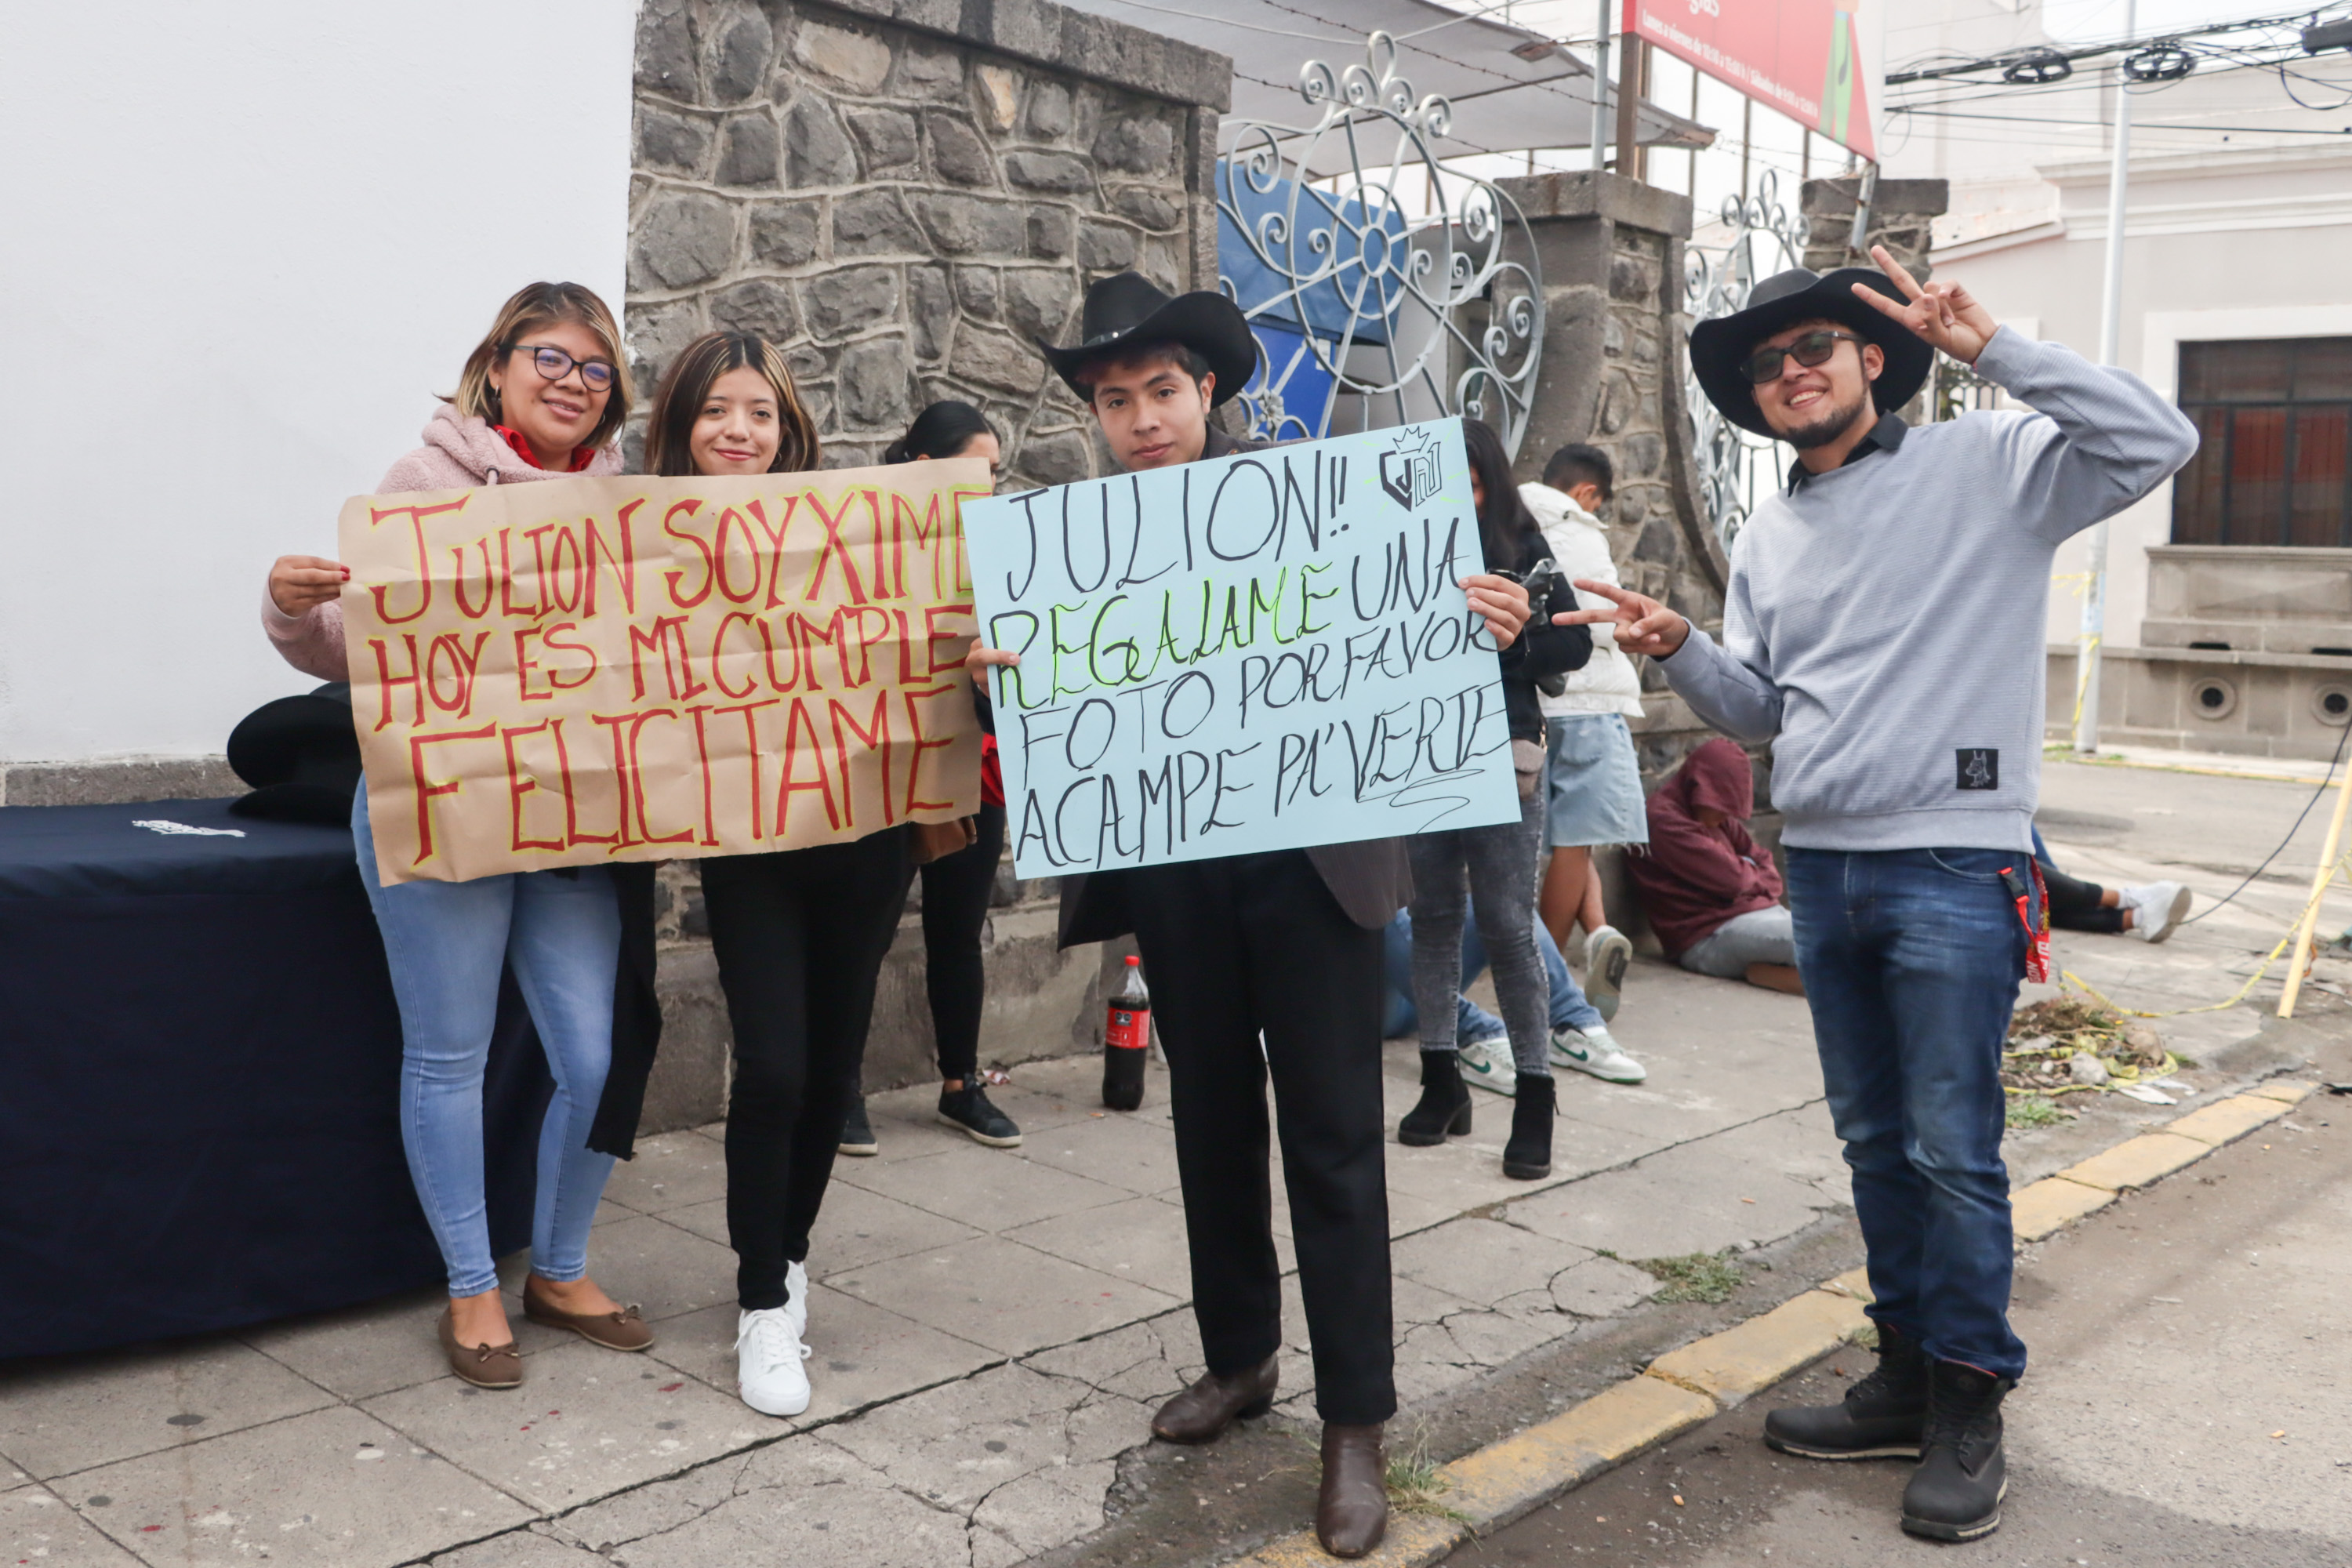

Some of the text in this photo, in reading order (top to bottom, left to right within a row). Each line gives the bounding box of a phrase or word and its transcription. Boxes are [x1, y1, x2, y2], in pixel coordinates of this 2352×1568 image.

[369, 494, 644, 624] JULION
[989, 517, 1470, 710] REGALAME UNA
[1007, 450, 1348, 602] JULION!!
[368, 630, 490, 731] HOY
[514, 622, 597, 702] ES
[713, 604, 973, 699] CUMPLE
[1019, 610, 1498, 791] FOTO POR FAVOR
[409, 683, 956, 866] FELICITAME
[1017, 742, 1262, 869] ACAMPE
[1342, 680, 1512, 802] VERTE
